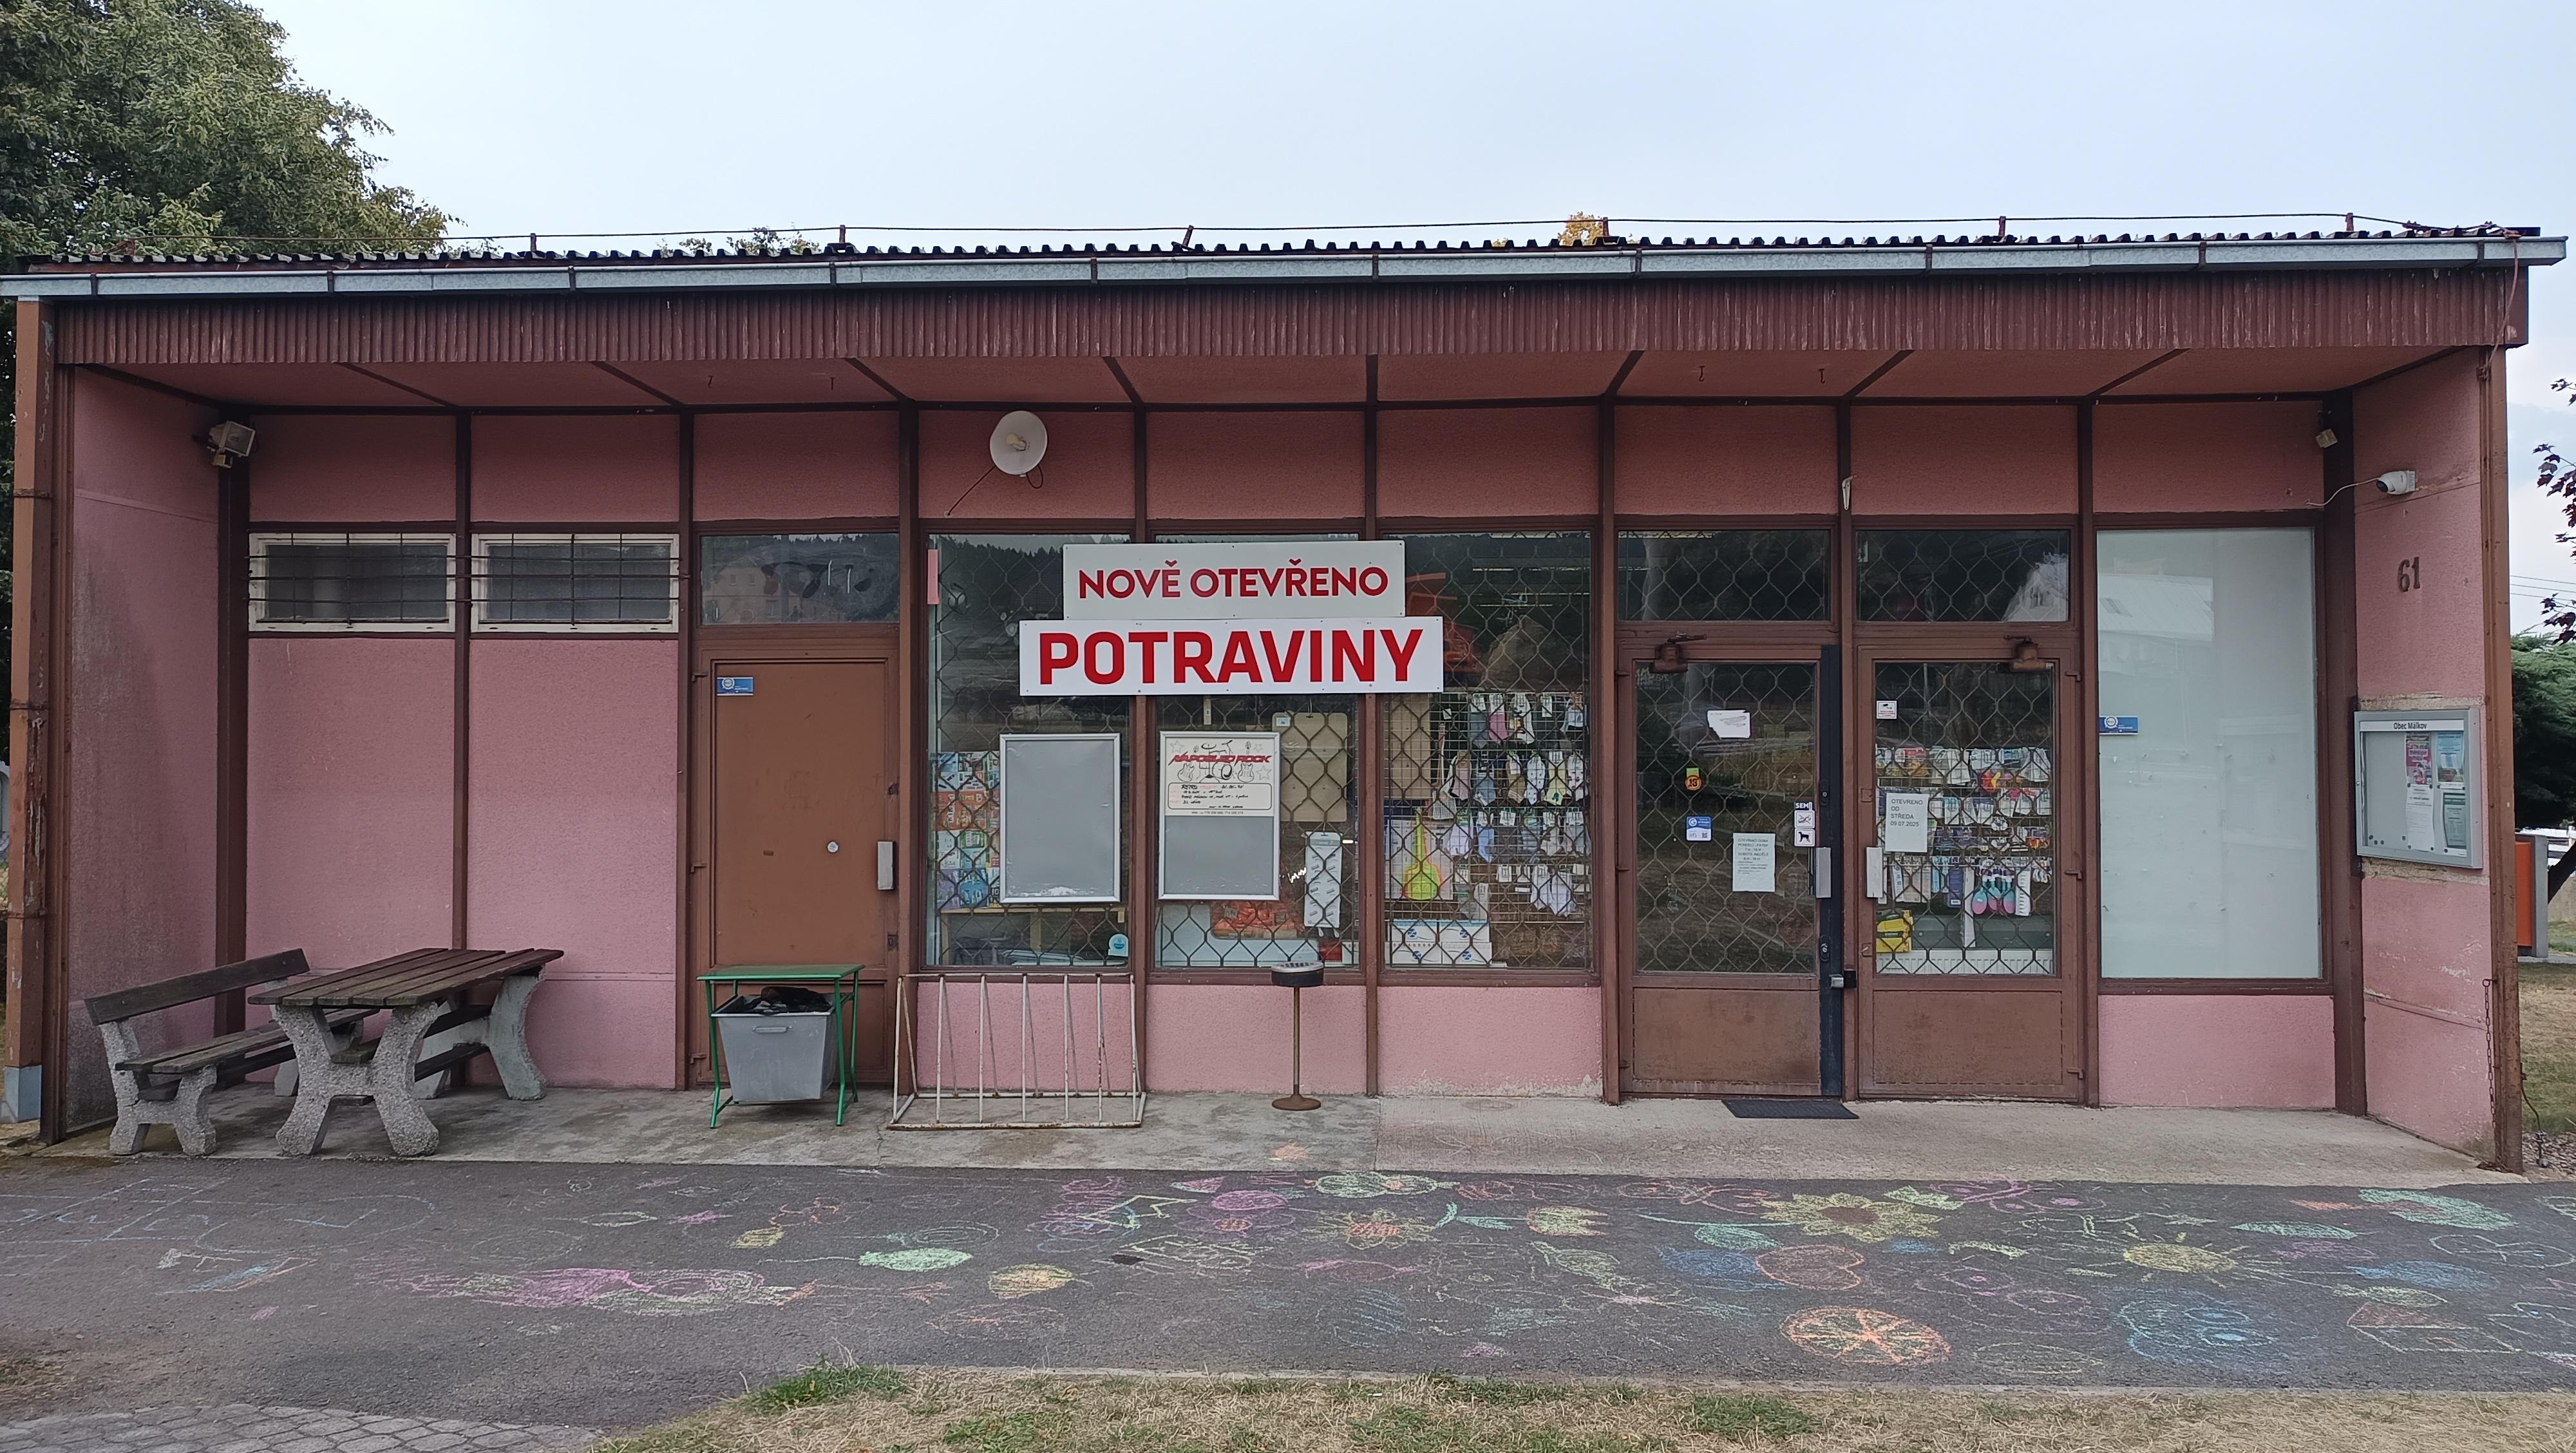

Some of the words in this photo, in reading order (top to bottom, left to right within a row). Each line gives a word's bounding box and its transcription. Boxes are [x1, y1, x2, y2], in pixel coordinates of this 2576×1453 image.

[1079, 560, 1180, 599] NOVĚ
[1191, 558, 1388, 598] OTEVŘENO
[2398, 556, 2421, 593] 61
[1039, 629, 1423, 685] POTRAVINY
[1234, 755, 1273, 766] ROCK
